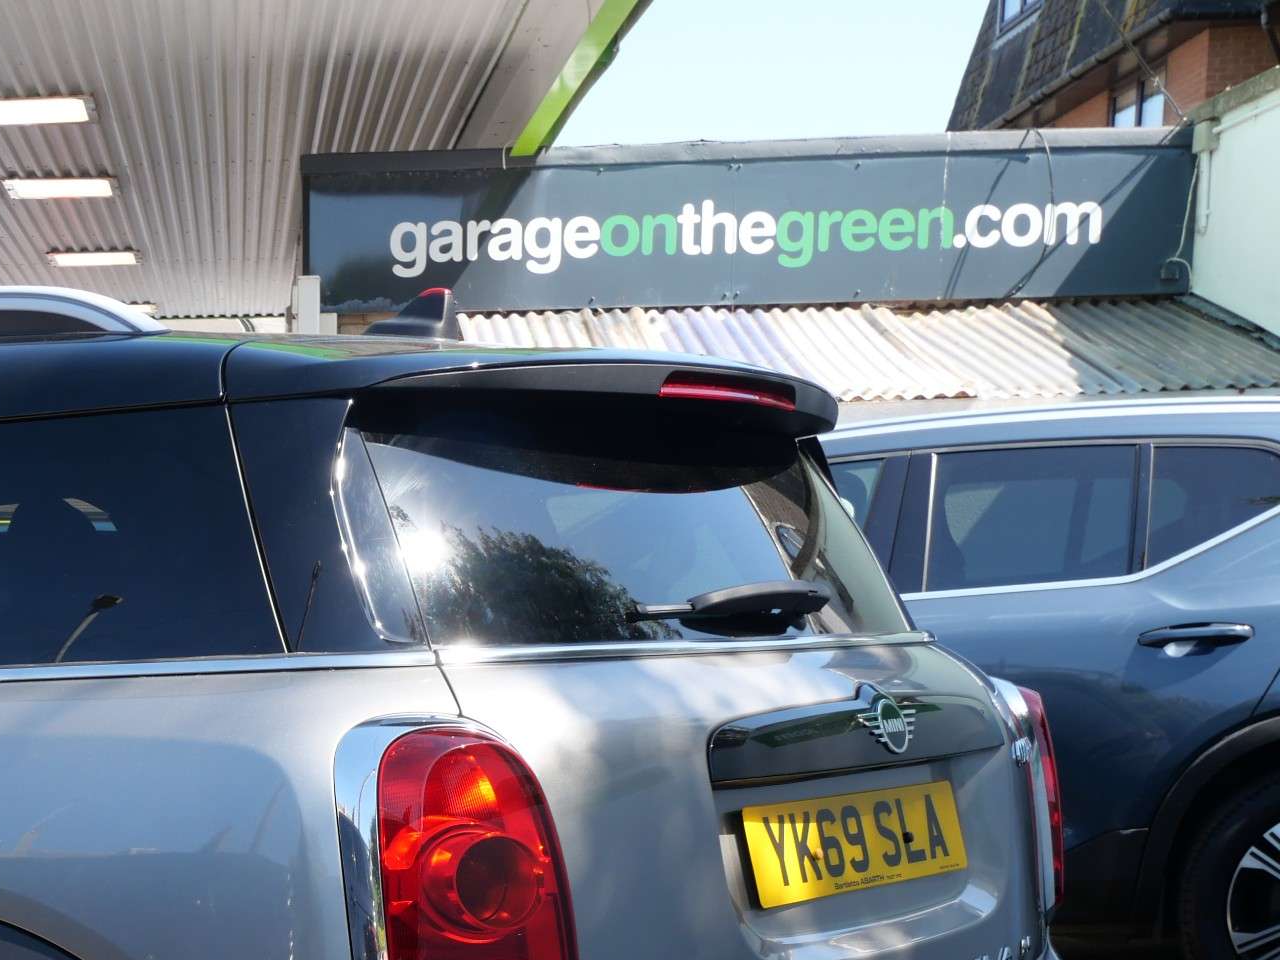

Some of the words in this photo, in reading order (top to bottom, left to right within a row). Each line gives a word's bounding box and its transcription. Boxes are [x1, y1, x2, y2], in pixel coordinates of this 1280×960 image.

[389, 198, 1104, 278] garageonthegreen.com
[882, 717, 905, 733] MINI
[762, 804, 870, 887] YK69
[873, 793, 950, 868] SLA
